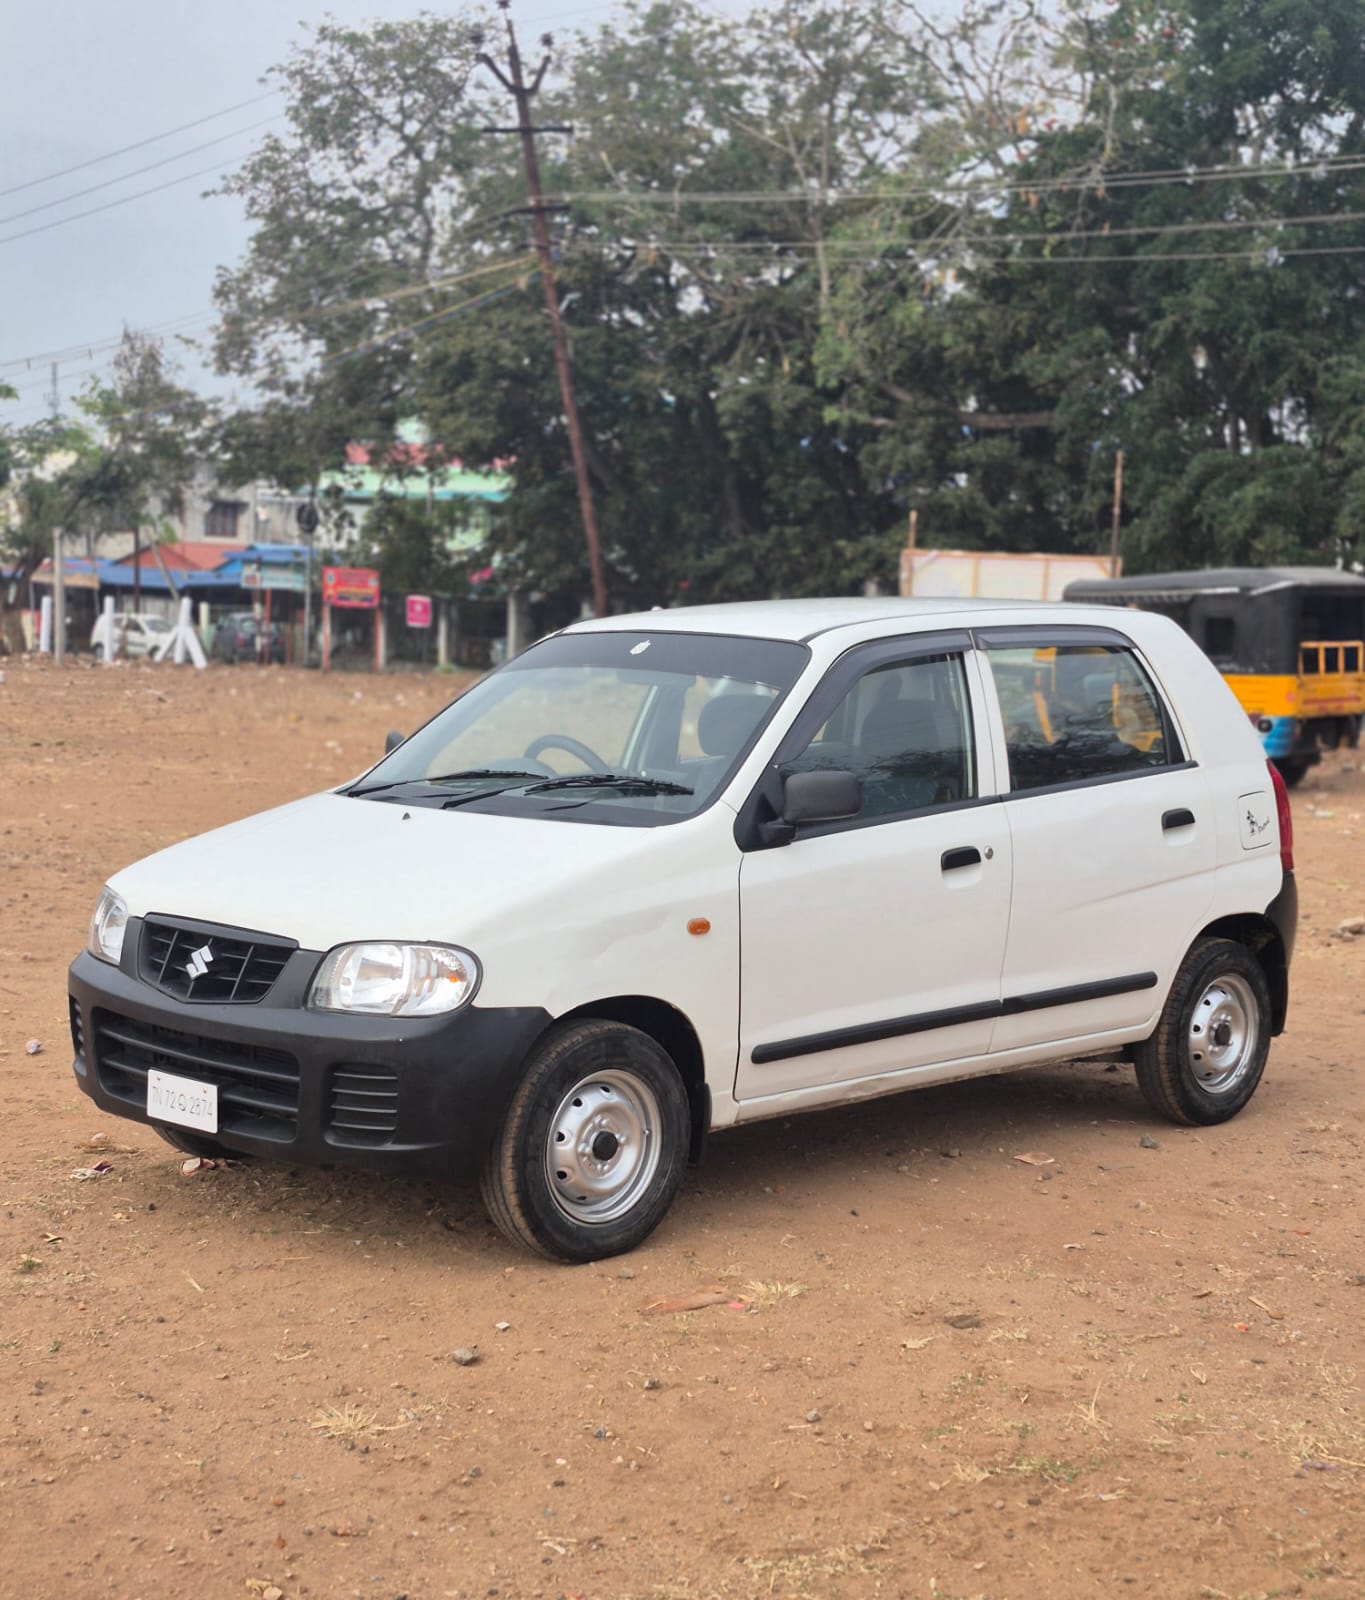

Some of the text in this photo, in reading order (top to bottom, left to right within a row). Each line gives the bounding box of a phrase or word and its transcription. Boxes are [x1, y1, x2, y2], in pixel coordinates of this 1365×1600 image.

[152, 1086, 162, 1105] TN
[165, 1089, 176, 1109] 72
[189, 1096, 213, 1119] 2874
